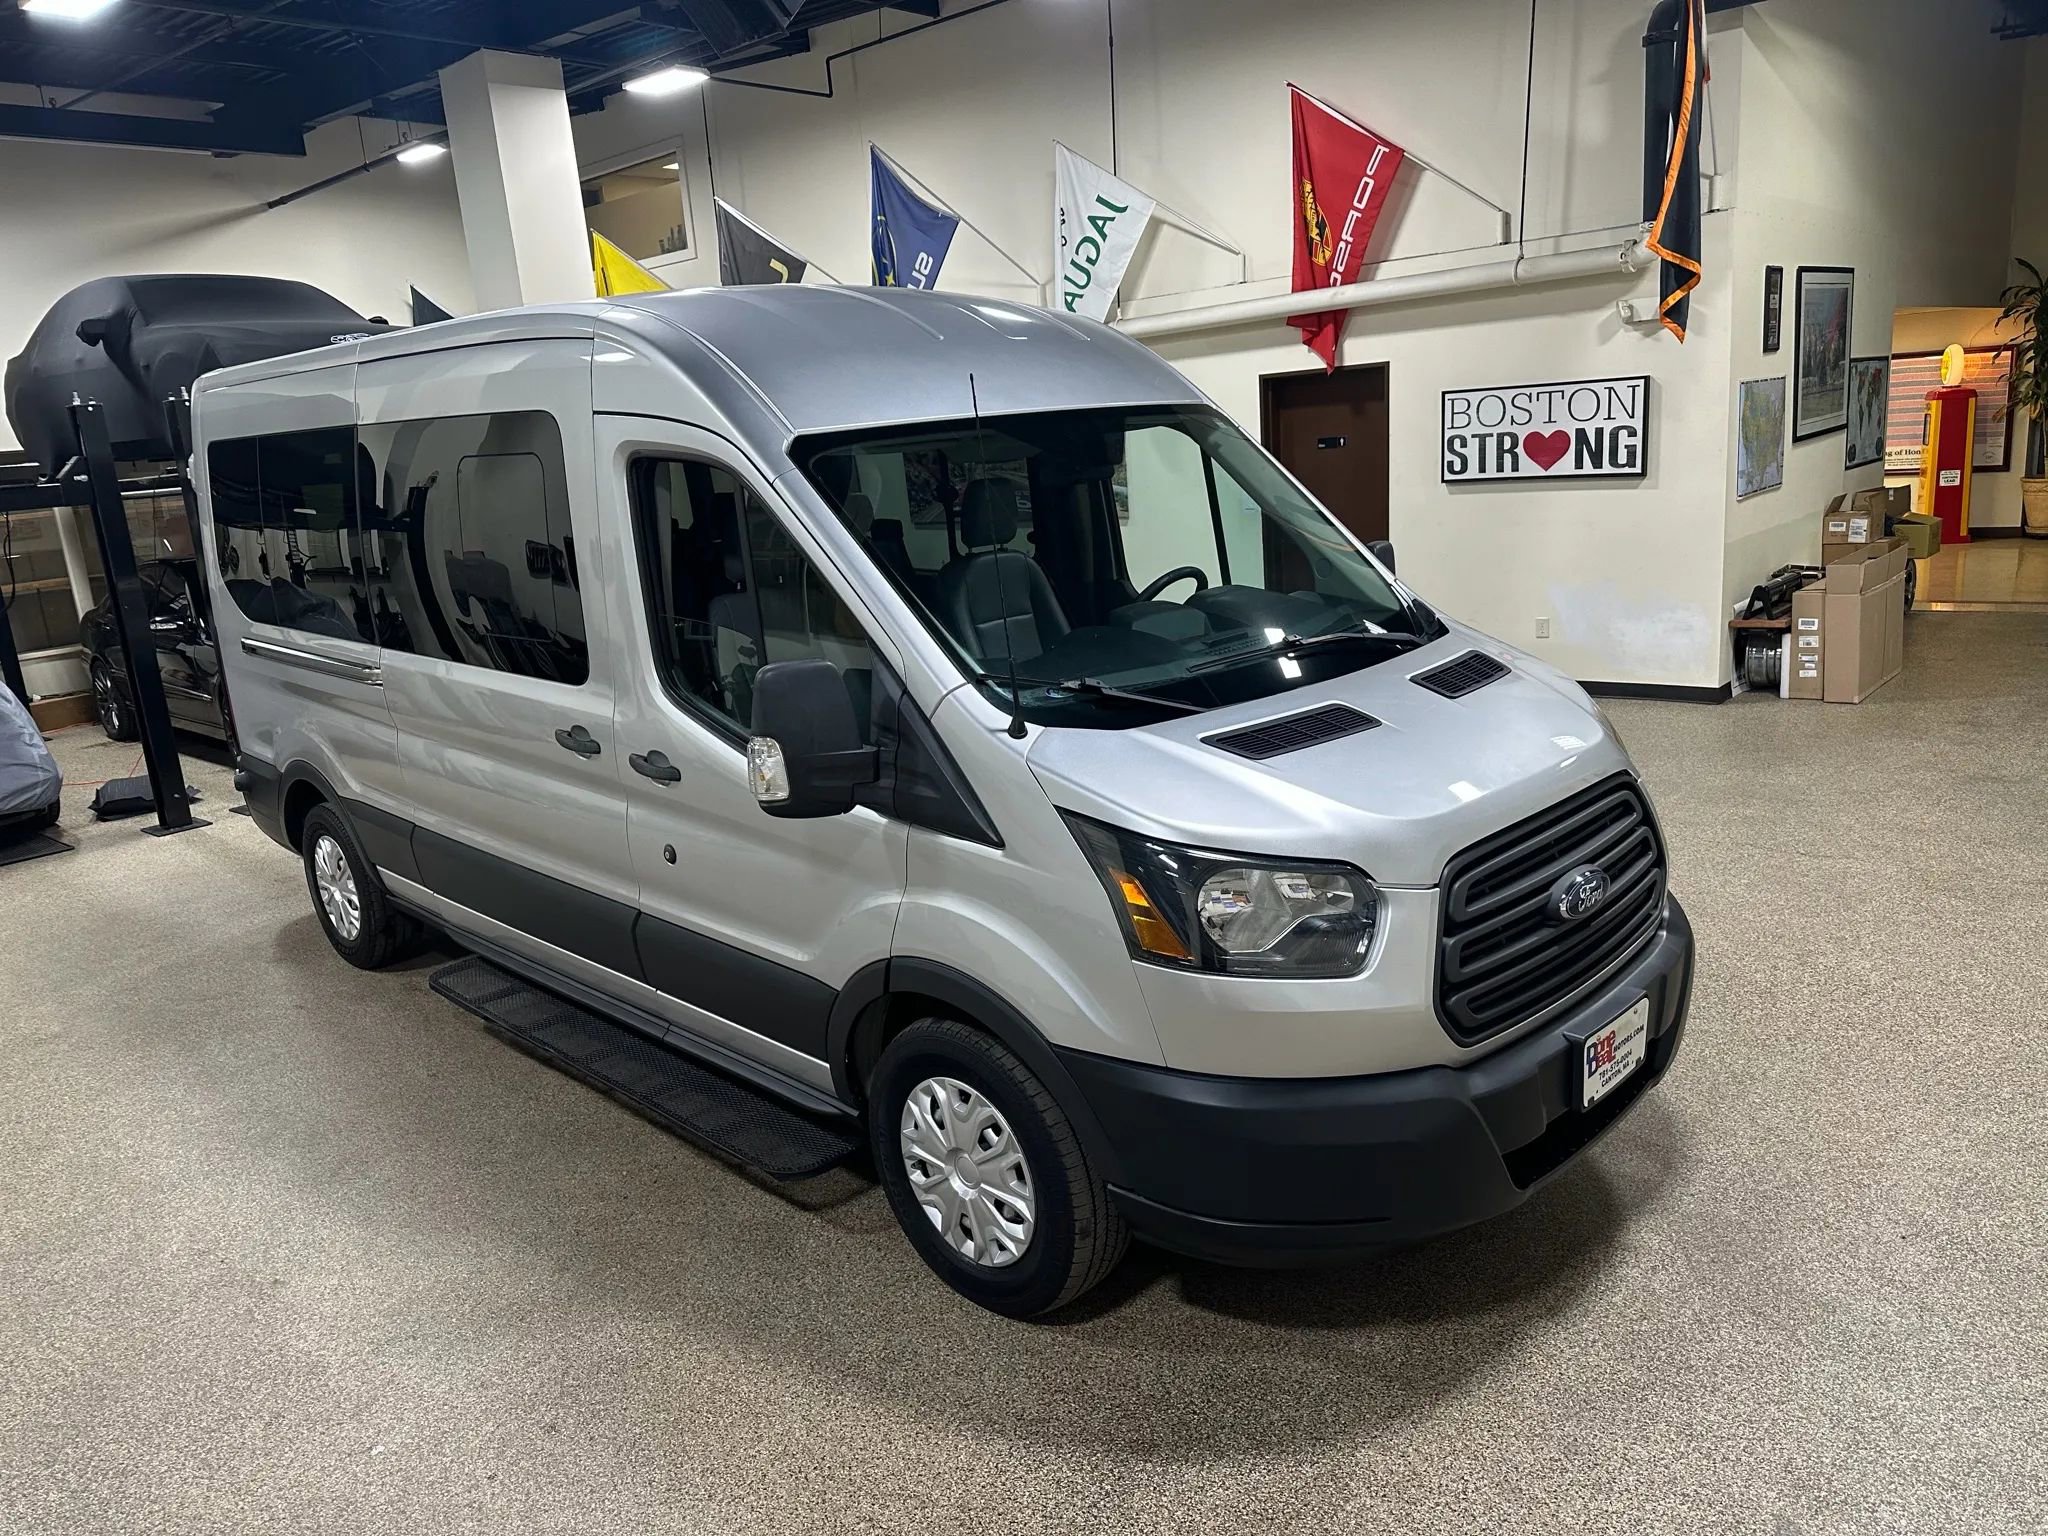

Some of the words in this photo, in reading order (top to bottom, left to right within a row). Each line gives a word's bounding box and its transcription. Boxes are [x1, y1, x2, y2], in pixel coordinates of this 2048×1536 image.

[1447, 385, 1640, 430] BOSTON
[1579, 880, 1603, 911] Ford
[1613, 1024, 1644, 1054] MOTORS.COM
